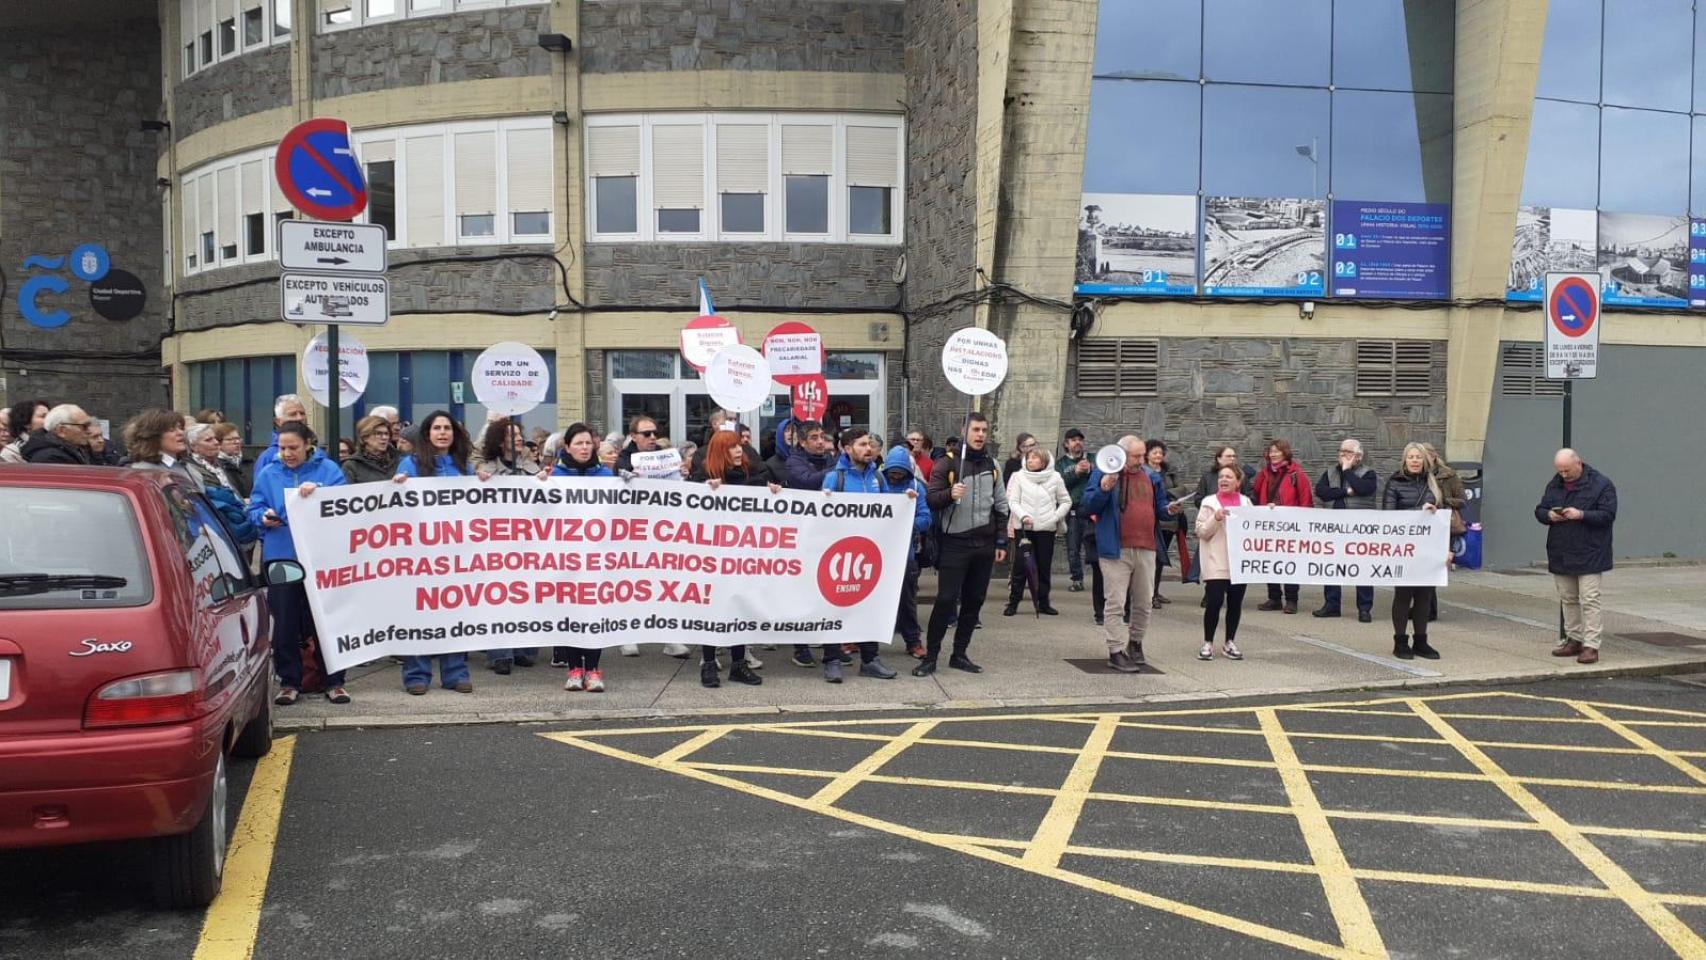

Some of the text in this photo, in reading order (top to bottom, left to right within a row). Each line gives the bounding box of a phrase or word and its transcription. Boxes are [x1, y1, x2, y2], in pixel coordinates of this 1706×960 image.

[314, 228, 354, 240] EXCEPTO
[1692, 222, 1706, 234] 03
[1336, 233, 1354, 246] 01
[304, 242, 364, 254] AMBULANCIA
[1691, 248, 1706, 260] 04
[1336, 262, 1355, 274] 02
[1142, 269, 1164, 282] 01
[1298, 272, 1320, 285] 02
[1691, 274, 1706, 286] 05
[286, 280, 384, 293] EXCEPTO VEHÍCULOS
[320, 488, 894, 518] ESCOLAS DEPORTIVAS MUNICIPAIS CONCELLO DA CORUÑA
[1255, 520, 1301, 532] PERSOAL
[1309, 522, 1380, 535] TRABALLADOR
[1383, 524, 1406, 536] DAS
[1408, 525, 1432, 536] EDM
[349, 518, 798, 553] POR UN SERVIZO DE CALIDADE
[1243, 538, 1416, 557] QUEREMOS COBRAR
[316, 552, 802, 590] MELLORAS LABORAIS E SALARIOS DIGNOS
[829, 552, 872, 582] CIG
[1241, 560, 1296, 576] PREGO
[1308, 562, 1360, 578] DIGNO
[836, 584, 860, 593] ENSINO
[416, 580, 712, 611] NOVOS PREGOS XA!
[337, 614, 842, 654] Na defensa dos nosos dereitos e dos usuarios e usuarias
[68, 638, 132, 656] Saxo
